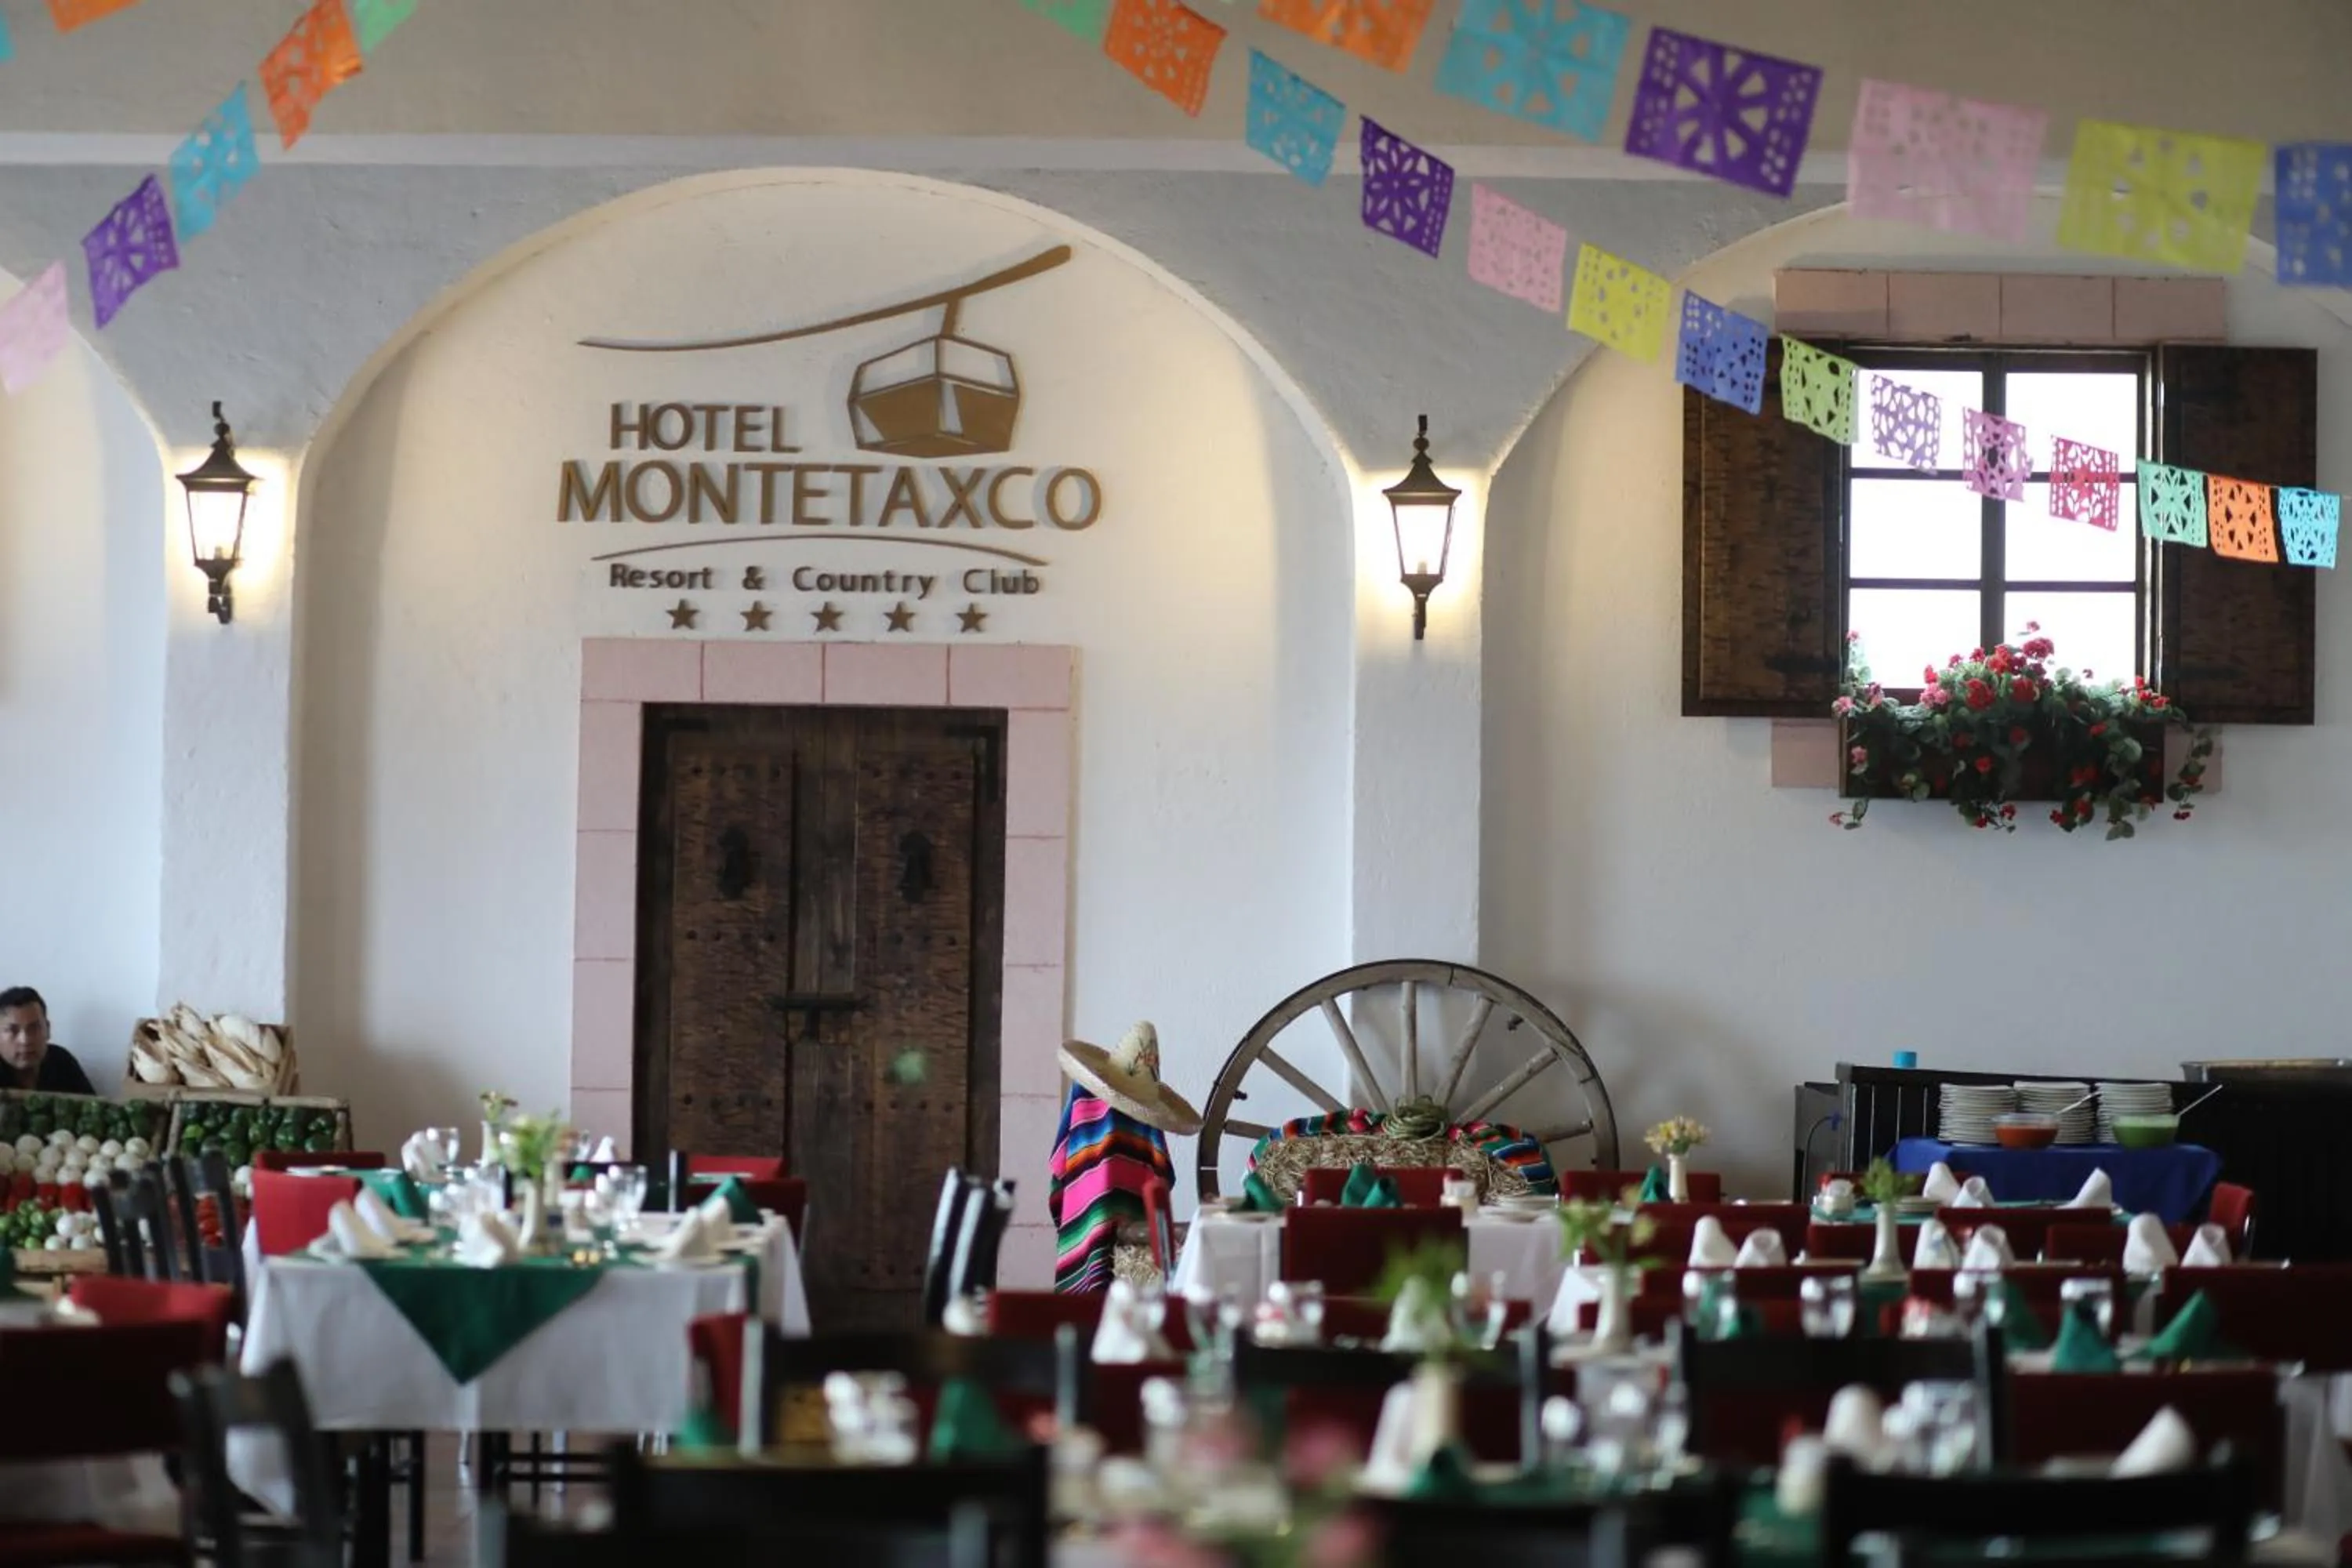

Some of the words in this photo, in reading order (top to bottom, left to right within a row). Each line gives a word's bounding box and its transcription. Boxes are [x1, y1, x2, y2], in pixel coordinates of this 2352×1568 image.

[609, 403, 801, 452] HOTEL
[557, 459, 1102, 531] MONTETAXCO
[609, 563, 713, 589] Resort
[742, 566, 765, 590] &
[792, 566, 935, 600] Country
[963, 568, 1041, 594] Club
